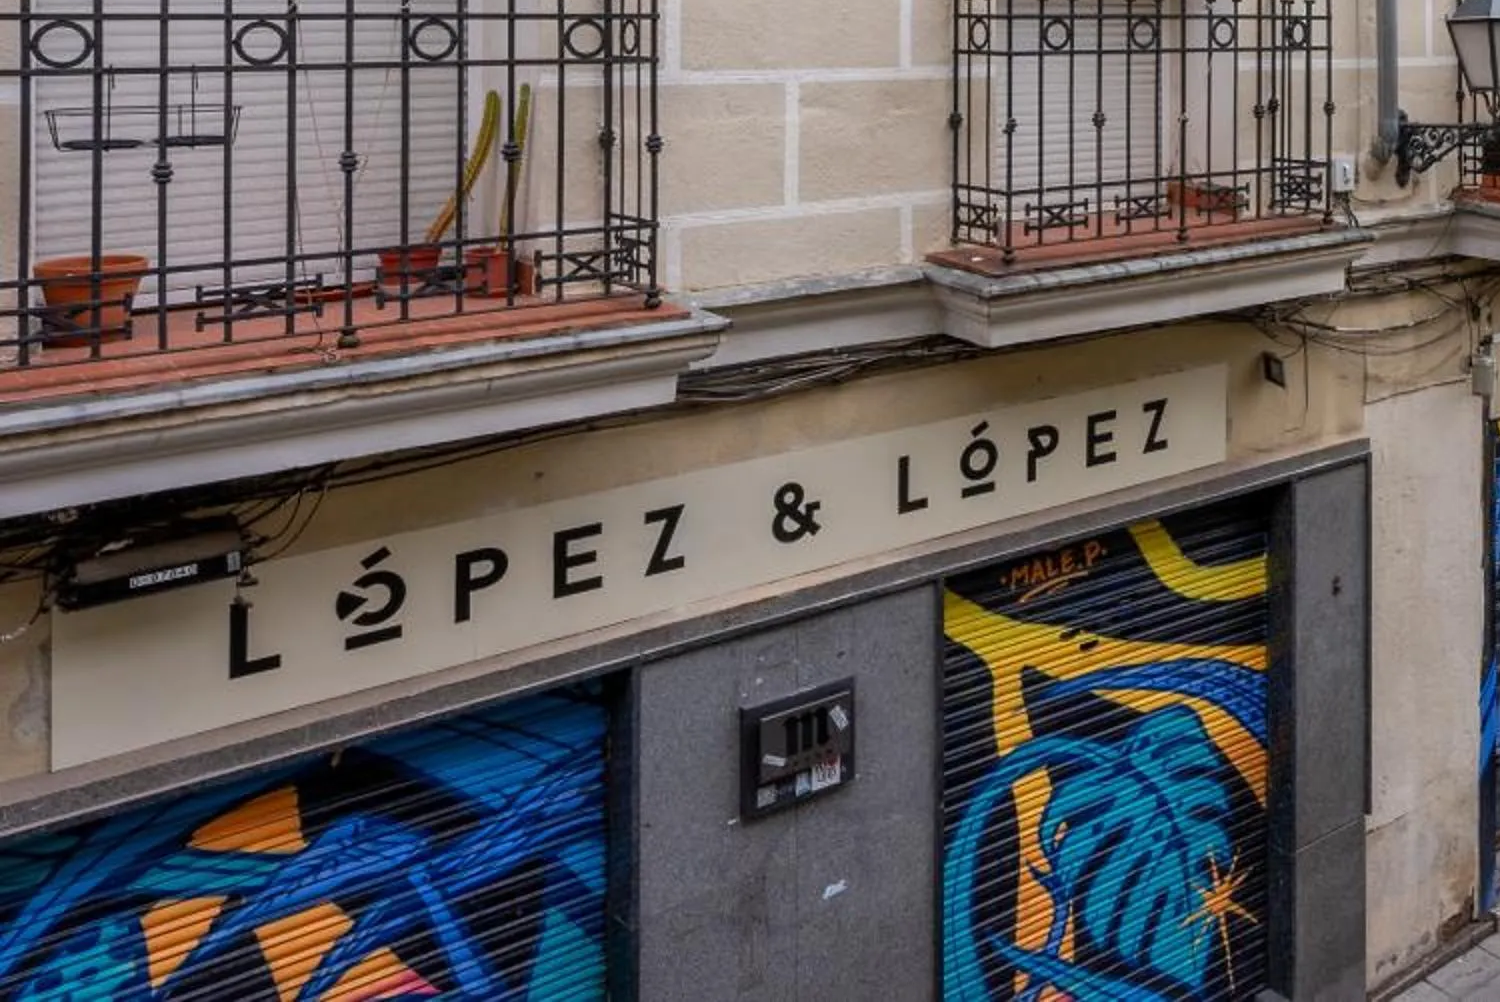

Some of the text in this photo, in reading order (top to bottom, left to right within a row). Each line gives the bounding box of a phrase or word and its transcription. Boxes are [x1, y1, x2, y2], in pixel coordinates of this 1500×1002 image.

[228, 397, 1169, 679] LÓPEZ & LÓPEZ
